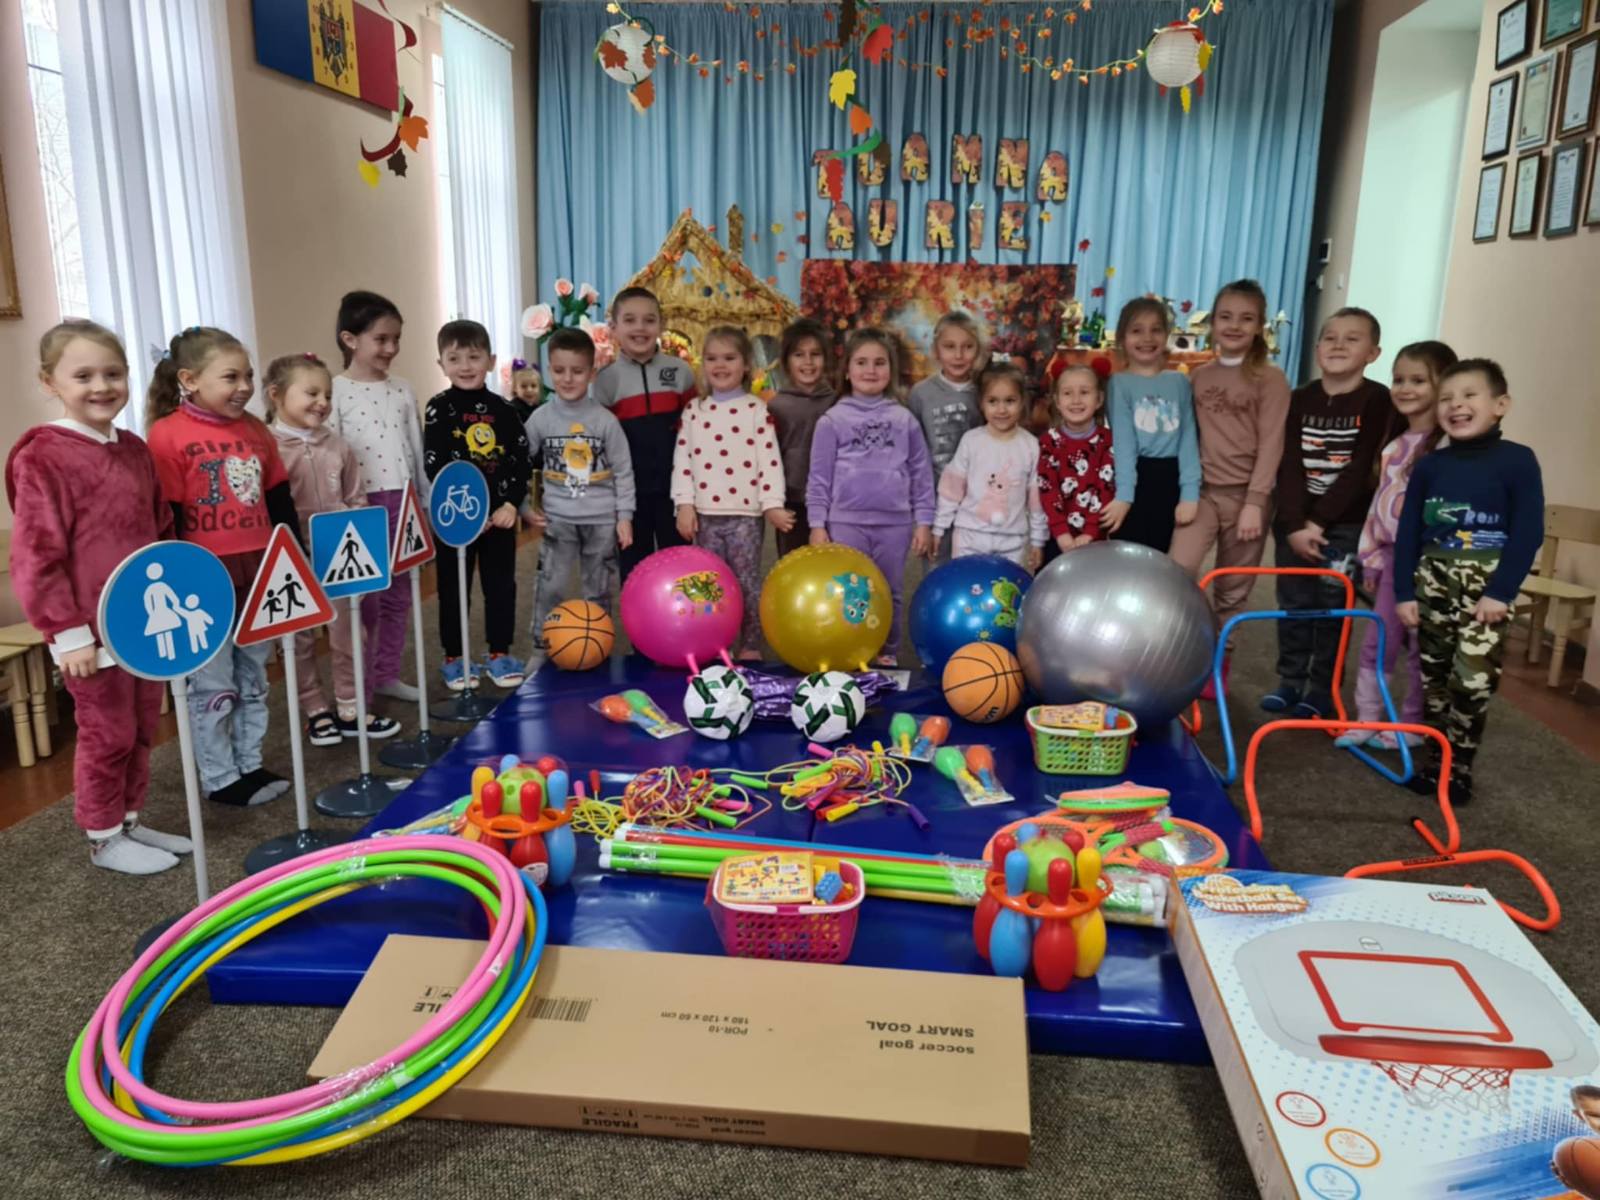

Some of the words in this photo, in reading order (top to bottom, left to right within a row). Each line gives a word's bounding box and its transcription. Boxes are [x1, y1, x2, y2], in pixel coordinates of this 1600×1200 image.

[865, 1020, 912, 1033] GOAL
[916, 1024, 975, 1039] SMART
[879, 1039, 914, 1050] goal
[919, 1043, 975, 1055] soccer
[582, 1116, 640, 1129] FRAGILE
